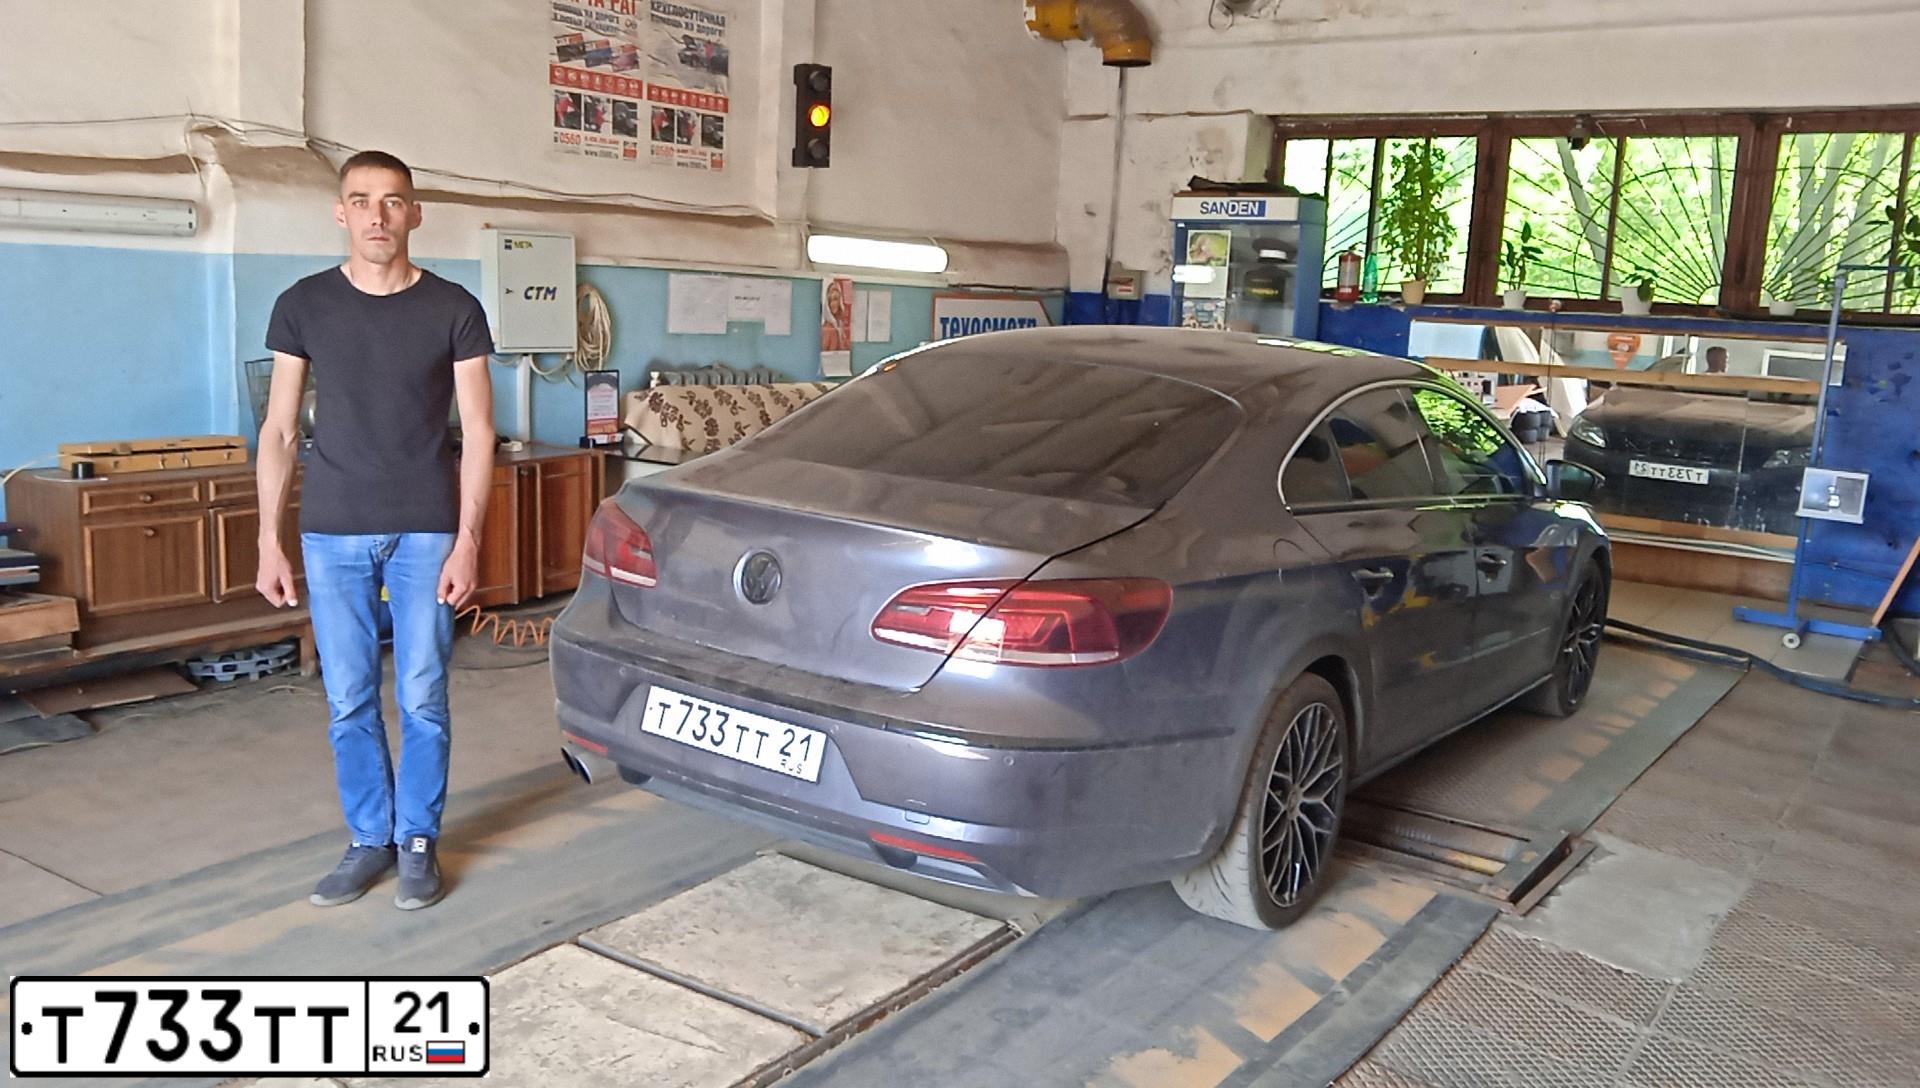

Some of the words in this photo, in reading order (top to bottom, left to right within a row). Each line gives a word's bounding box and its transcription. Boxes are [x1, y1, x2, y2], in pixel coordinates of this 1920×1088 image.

[1199, 201, 1259, 215] SANDEN
[523, 286, 557, 301] СТМ
[658, 699, 769, 759] Т733ТТ
[779, 728, 812, 762] 21
